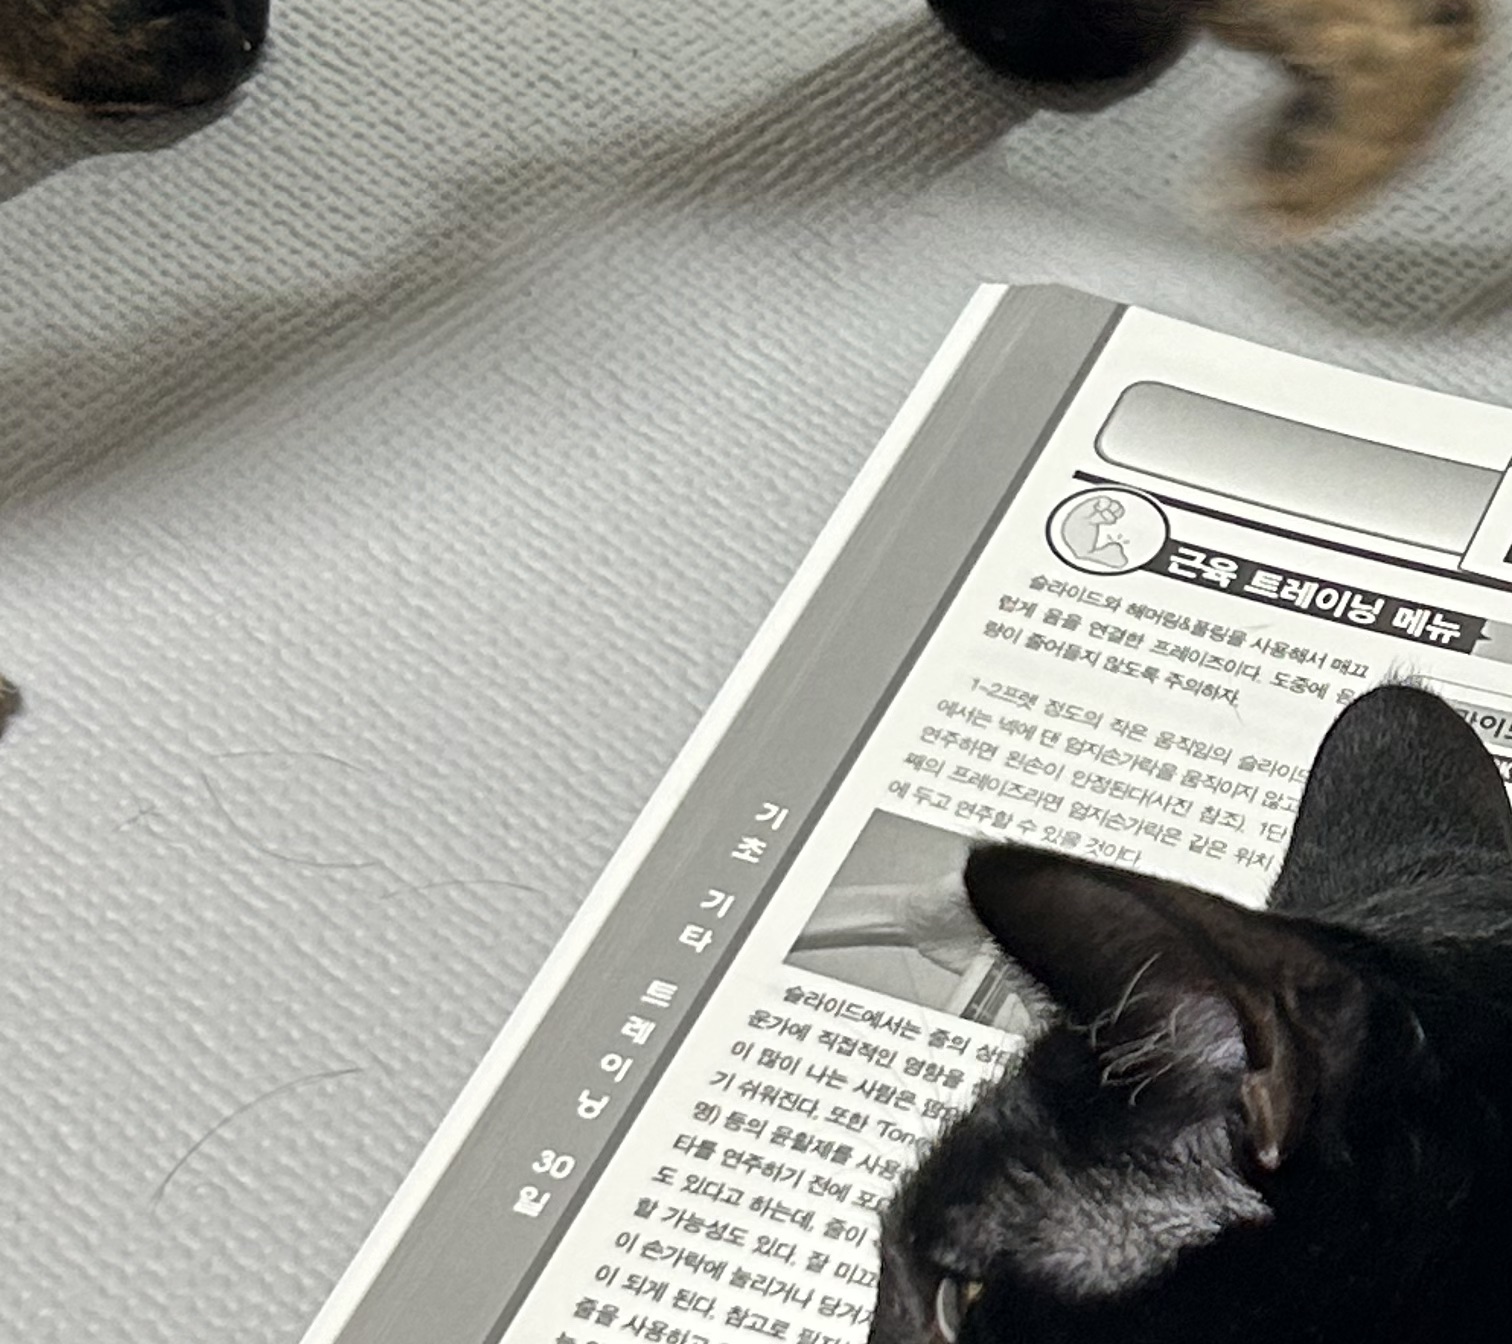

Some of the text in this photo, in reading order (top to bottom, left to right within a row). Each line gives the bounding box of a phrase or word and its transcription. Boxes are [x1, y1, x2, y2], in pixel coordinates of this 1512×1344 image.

[1028, 574, 1123, 614] 슬라이드와
[1249, 637, 1329, 670] 사용해서
[1330, 658, 1370, 679] 매끄
[1167, 546, 1461, 644] 근육 트레이닝 메뉴
[982, 619, 1240, 709] 량이 줄어들지 않도록 주의하자.
[1042, 607, 1083, 632] 음을
[1088, 621, 1146, 650] 연결한
[1148, 639, 1262, 682] 프레이즈이다.
[1269, 671, 1330, 700] 도중에
[936, 698, 1306, 814] 에서는 넥에 댄 엄지손가락을 움직이지 않고
[1043, 698, 1105, 731] 정도의
[1109, 717, 1149, 743] 작은
[1153, 730, 1233, 766] 움직임의
[902, 752, 1275, 872] 째의 프레이즈라면 엄지손가락은 같은 위치
[919, 725, 1000, 762] 연주하면
[1003, 750, 1066, 782] 왼손이
[1199, 805, 1246, 833] 참조).
[1259, 821, 1289, 844] 1단
[730, 800, 791, 866] 기초
[887, 779, 1143, 872] 에 두고 연주할 수 있을 것이다.
[677, 887, 737, 955] 기타
[576, 977, 679, 1122] 트레이닝
[747, 1009, 965, 1090] 운가에 직접적인 영향을
[782, 985, 922, 1041] 슬라이드에서는
[927, 1027, 972, 1057] 줄의
[708, 1070, 737, 1092] 기
[737, 1079, 820, 1121] 쉬워진다.
[824, 1105, 870, 1134] 또한
[730, 1040, 755, 1062] 이
[756, 1047, 803, 1076] 많이
[805, 1063, 849, 1090] 나는
[852, 1078, 917, 1112] 사람은
[672, 1133, 718, 1161] 타를
[720, 1148, 806, 1189] 연주하기
[807, 1174, 853, 1203] 전에
[692, 1100, 722, 1126] 명)
[723, 1110, 769, 1140] 등의
[769, 1125, 854, 1166] 윤활제를
[633, 1197, 659, 1220] 할
[660, 1206, 749, 1248] 가능성도
[751, 1235, 797, 1266] 있다.
[805, 1250, 831, 1274] 잘
[651, 1165, 678, 1186] 도
[679, 1174, 745, 1207] 있다고
[748, 1195, 816, 1232] 하는데,
[822, 1216, 869, 1248] 줄이
[594, 1264, 621, 1288] 이
[620, 1273, 670, 1303] 되게
[671, 1288, 717, 1320] 된다.
[724, 1305, 791, 1341] 참고로
[614, 1231, 641, 1254] 이
[639, 1239, 729, 1282] 손가락에
[728, 1266, 816, 1310] 눌리거나
[572, 1296, 620, 1328] 줄을
